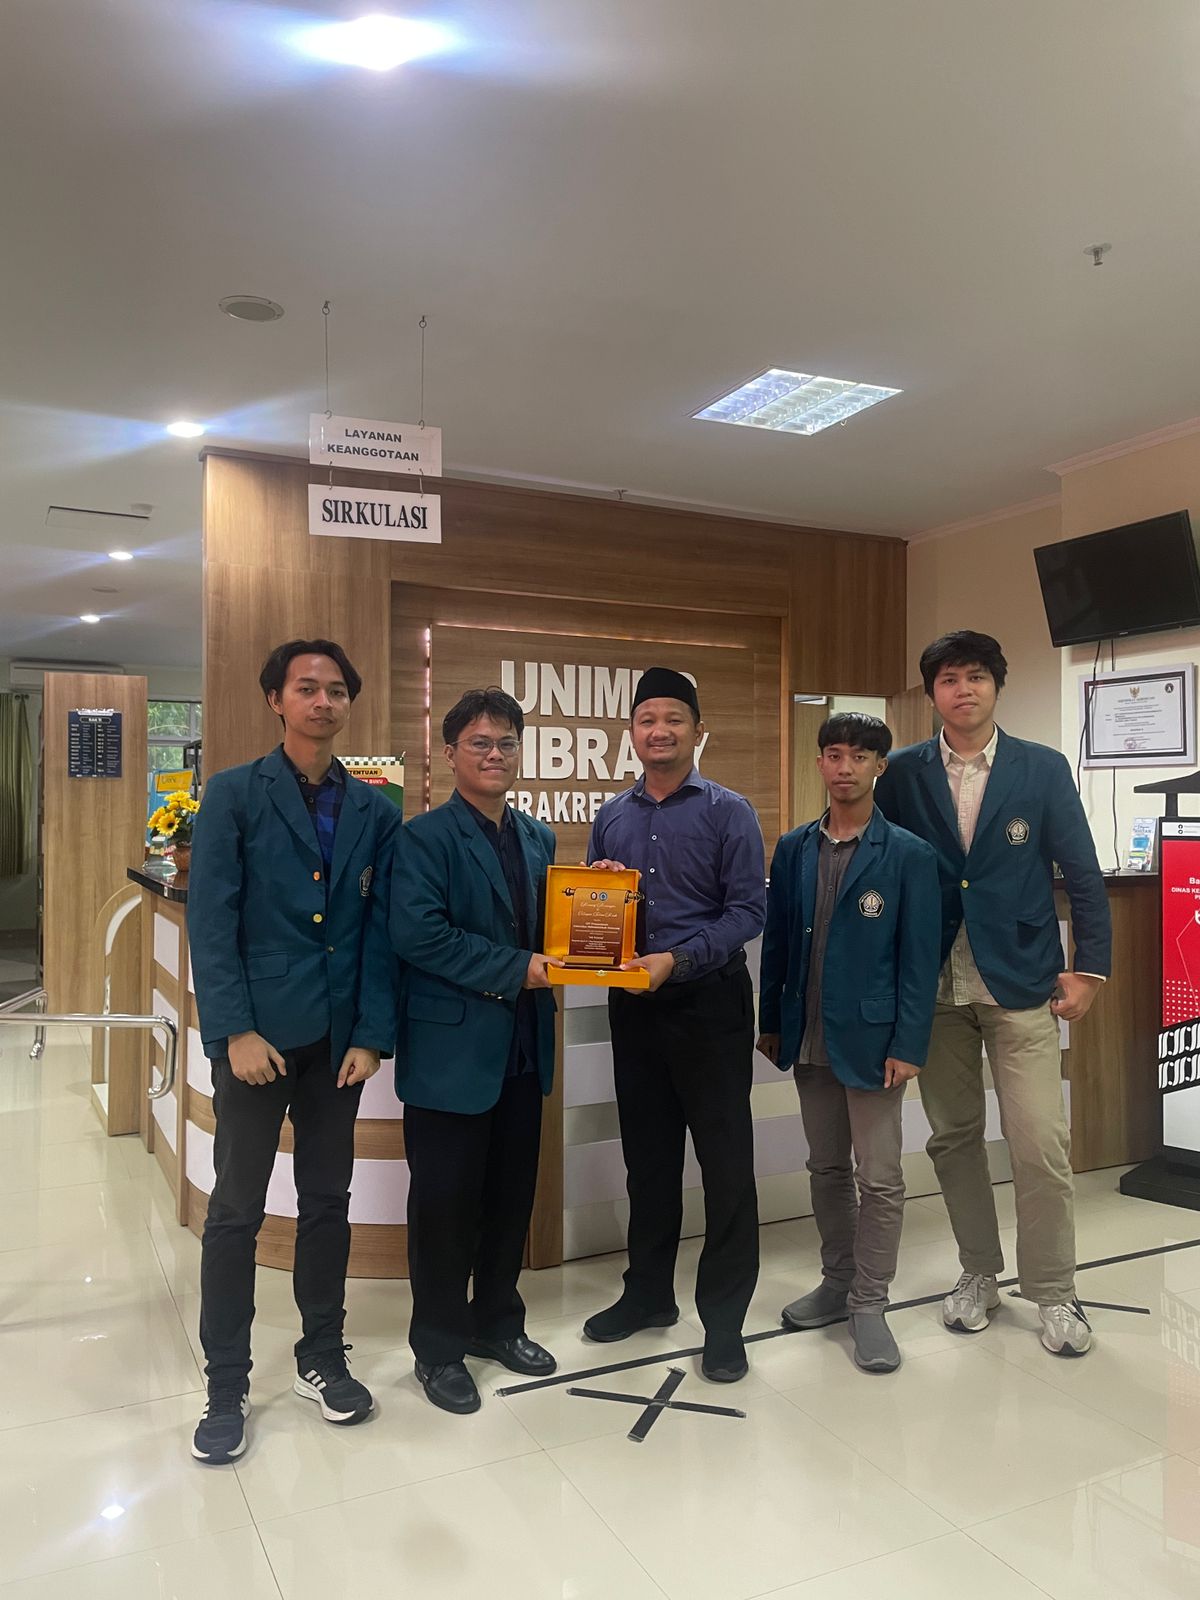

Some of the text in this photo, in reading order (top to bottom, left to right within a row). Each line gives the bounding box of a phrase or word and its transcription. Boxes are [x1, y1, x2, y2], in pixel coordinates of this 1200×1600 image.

[344, 428, 402, 443] LAYANAN
[327, 444, 419, 461] KEANGGOTAAN
[322, 498, 428, 530] SIRKULASI
[500, 660, 698, 721] UNIM
